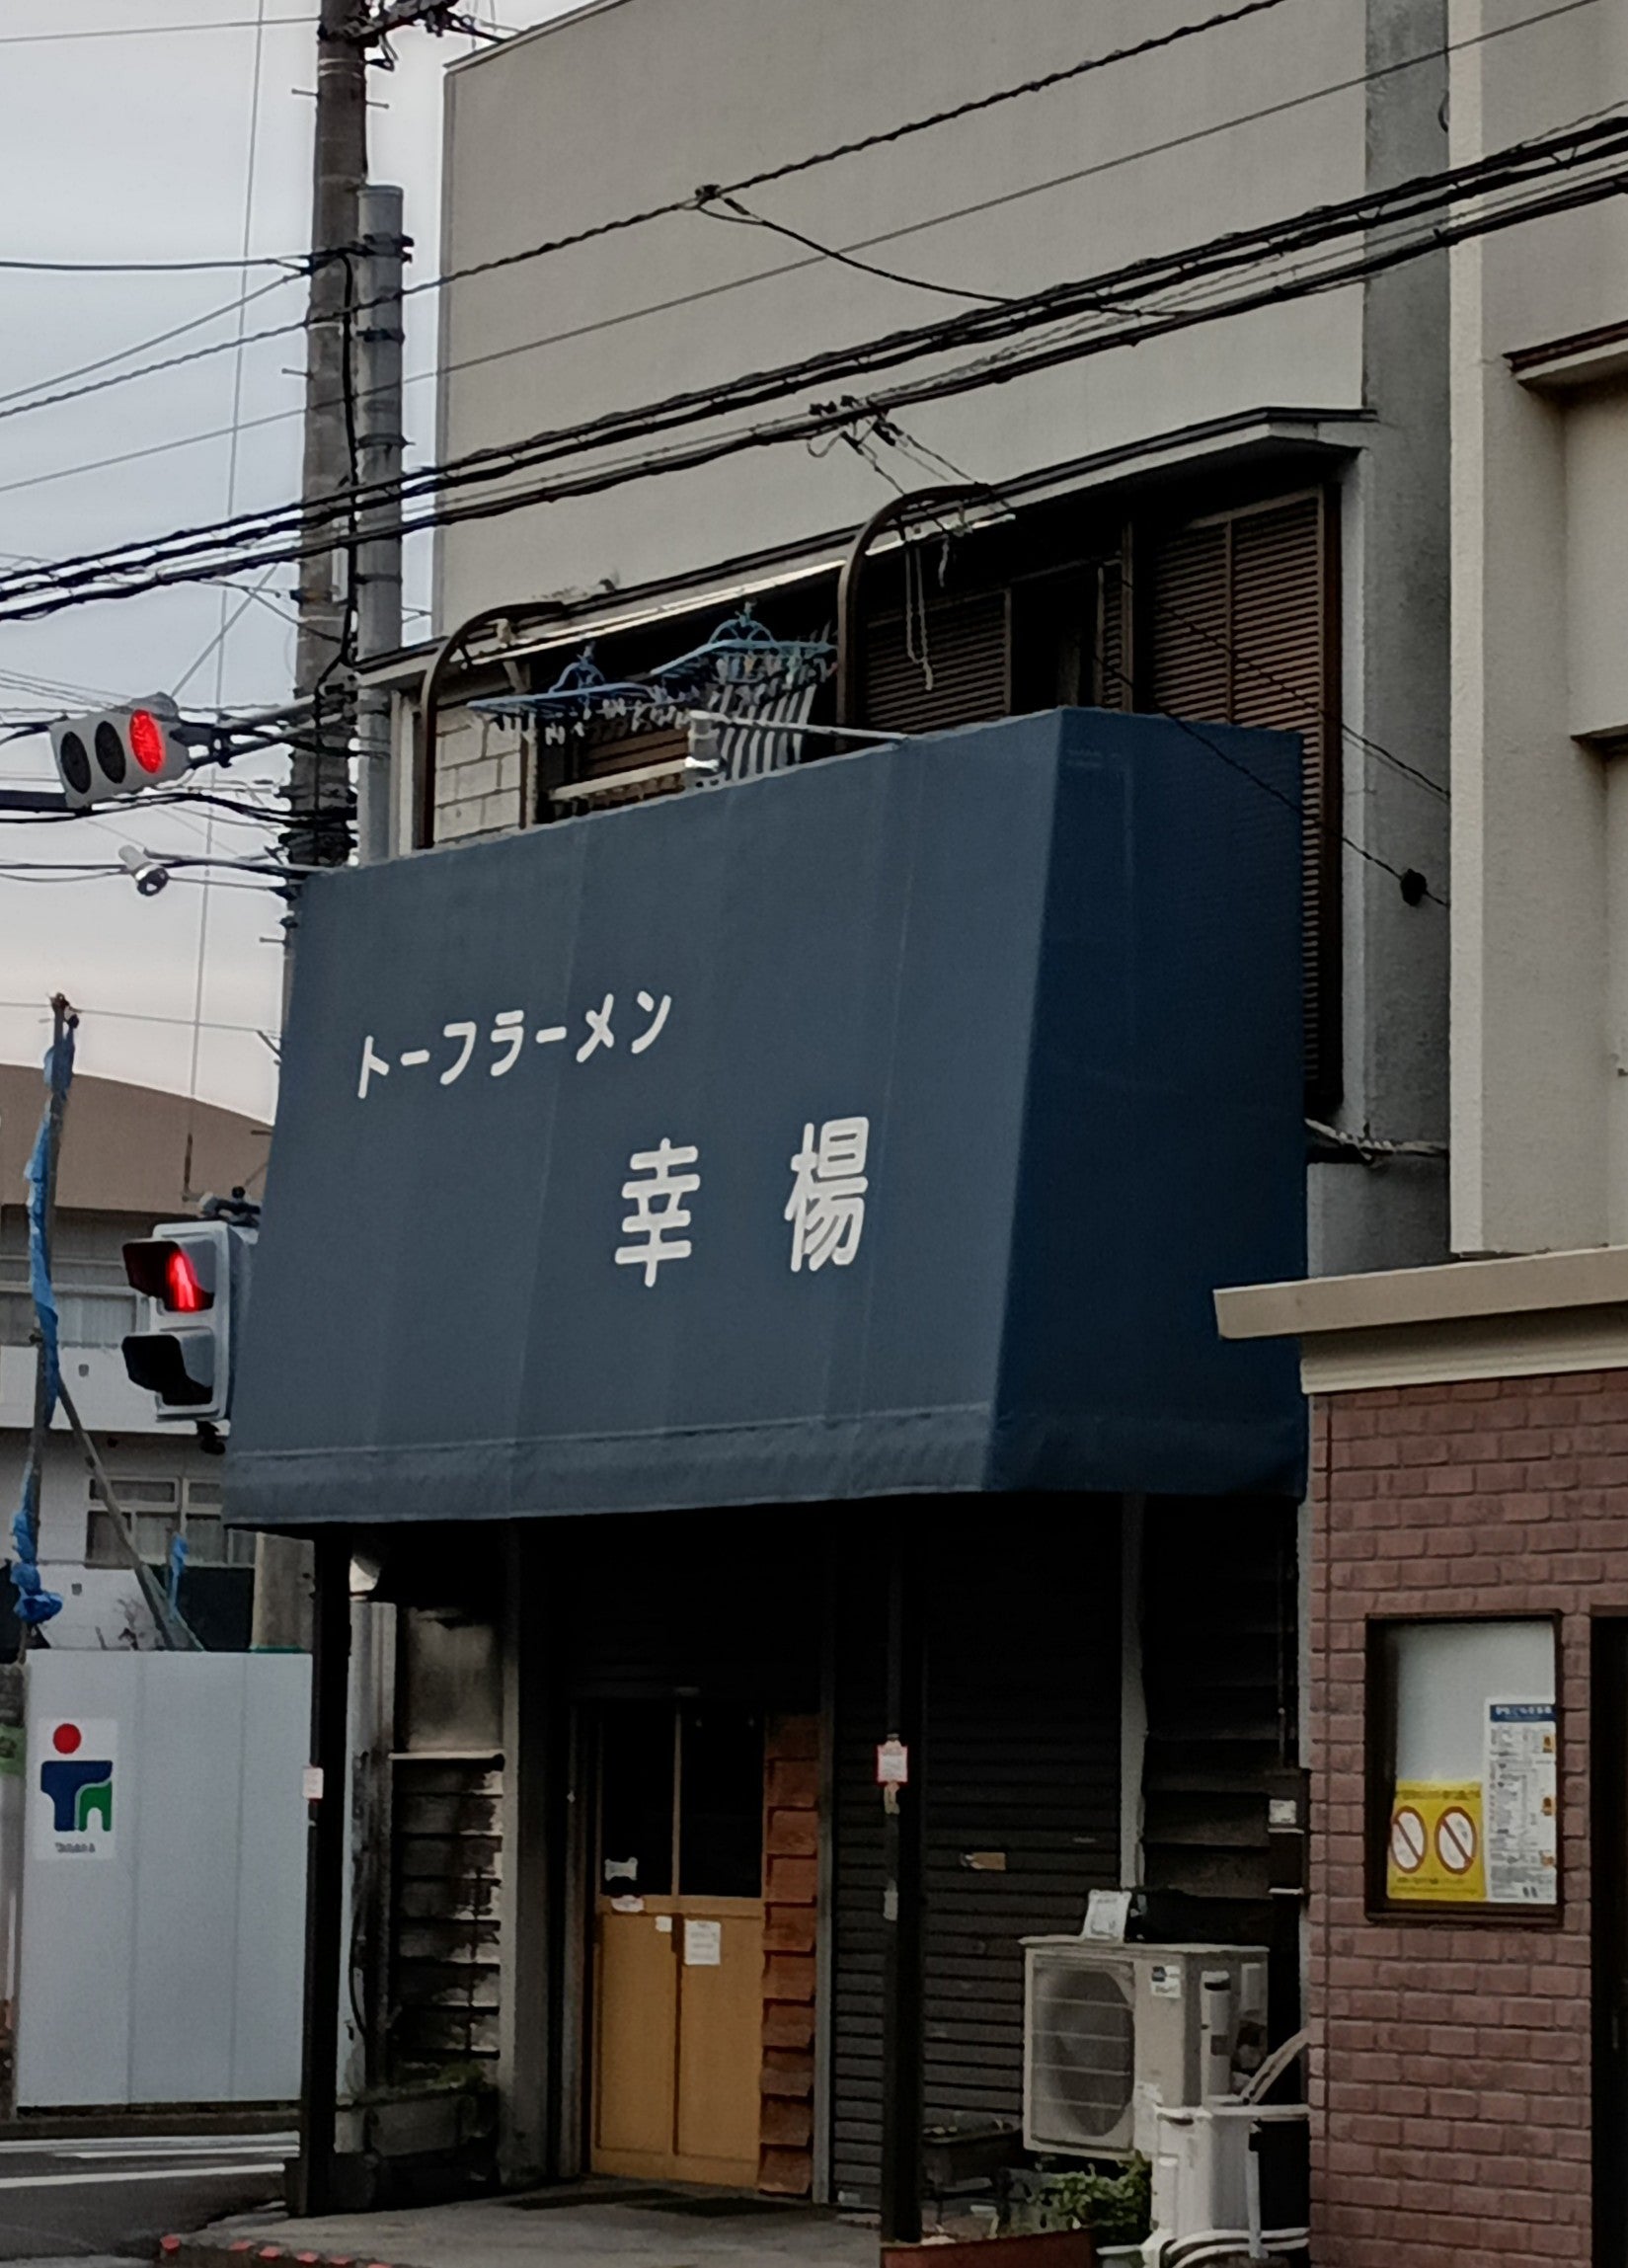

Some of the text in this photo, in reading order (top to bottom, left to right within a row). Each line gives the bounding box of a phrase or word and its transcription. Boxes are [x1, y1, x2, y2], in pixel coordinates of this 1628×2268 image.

[357, 990, 672, 1099] トーフラーメン
